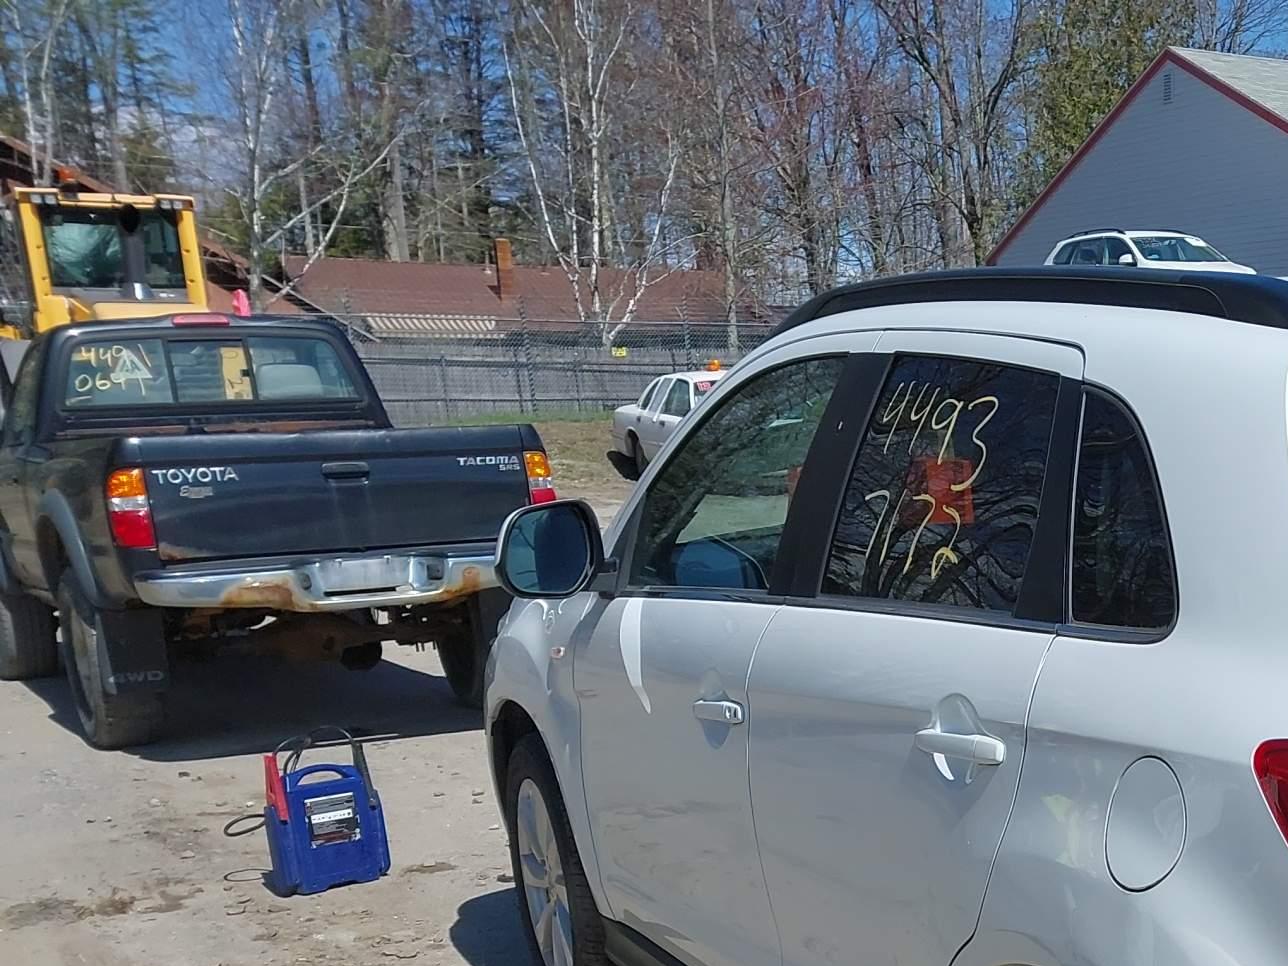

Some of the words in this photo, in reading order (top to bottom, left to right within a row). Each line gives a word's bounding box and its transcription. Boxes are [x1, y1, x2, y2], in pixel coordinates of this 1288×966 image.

[456, 455, 520, 466] TACOMA
[882, 380, 999, 491] 4493
[151, 466, 240, 484] TOYOTA
[865, 489, 961, 580] 7172
